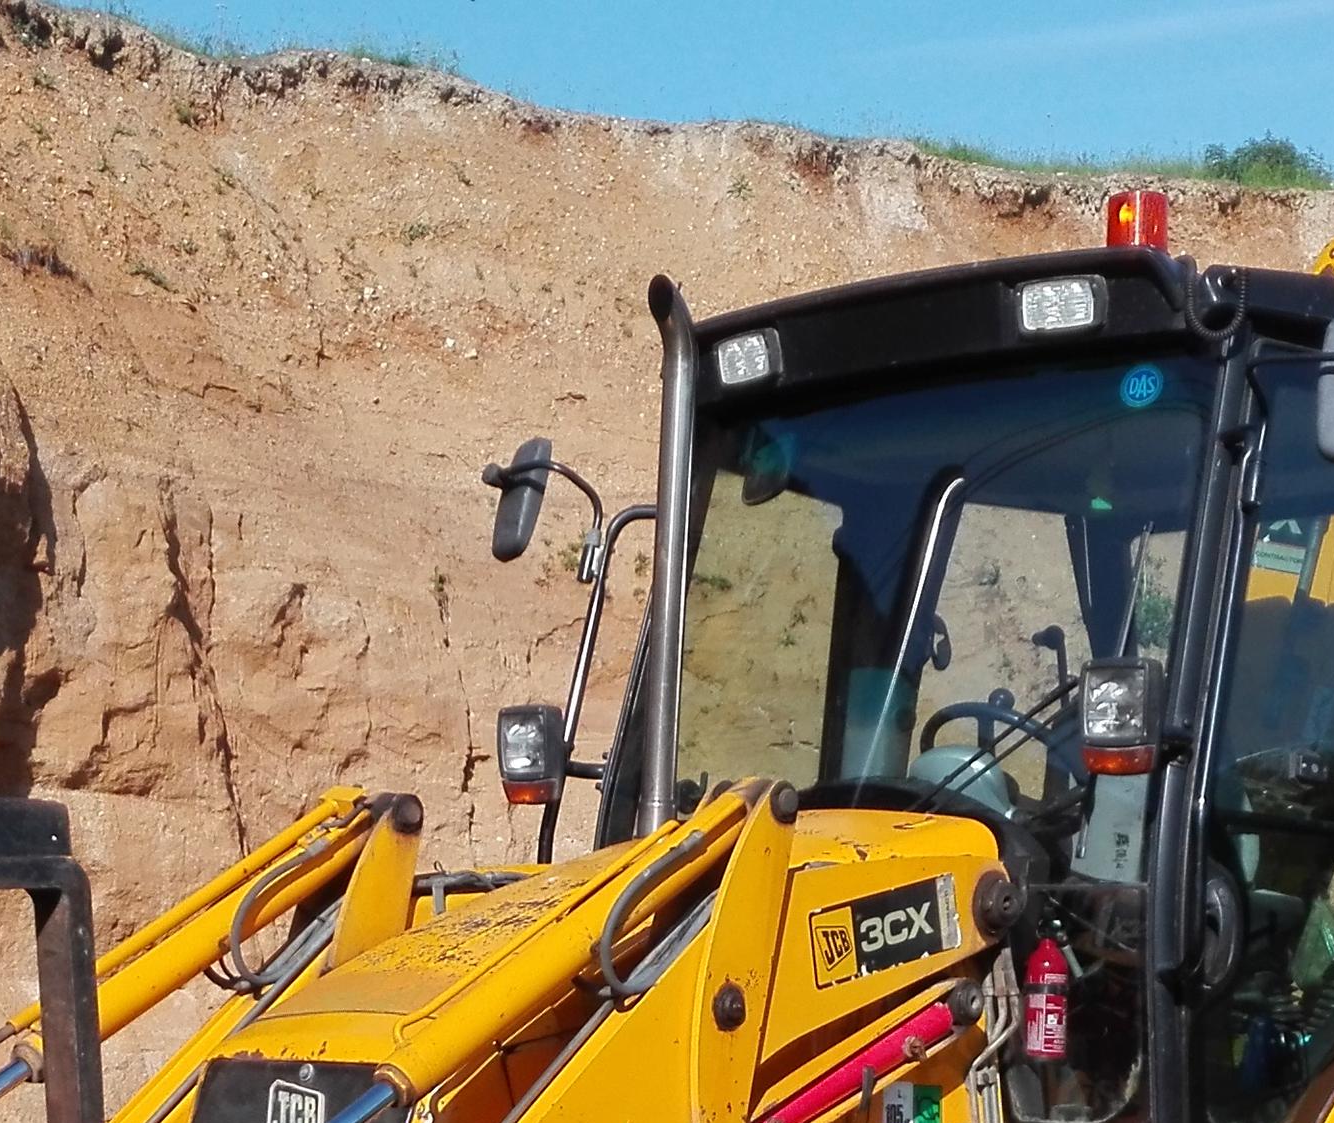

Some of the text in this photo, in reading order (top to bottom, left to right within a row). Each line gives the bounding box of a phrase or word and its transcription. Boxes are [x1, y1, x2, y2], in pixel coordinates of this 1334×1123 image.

[1129, 375, 1155, 398] DAS
[822, 927, 851, 965] JCB
[859, 902, 934, 951] 3CX
